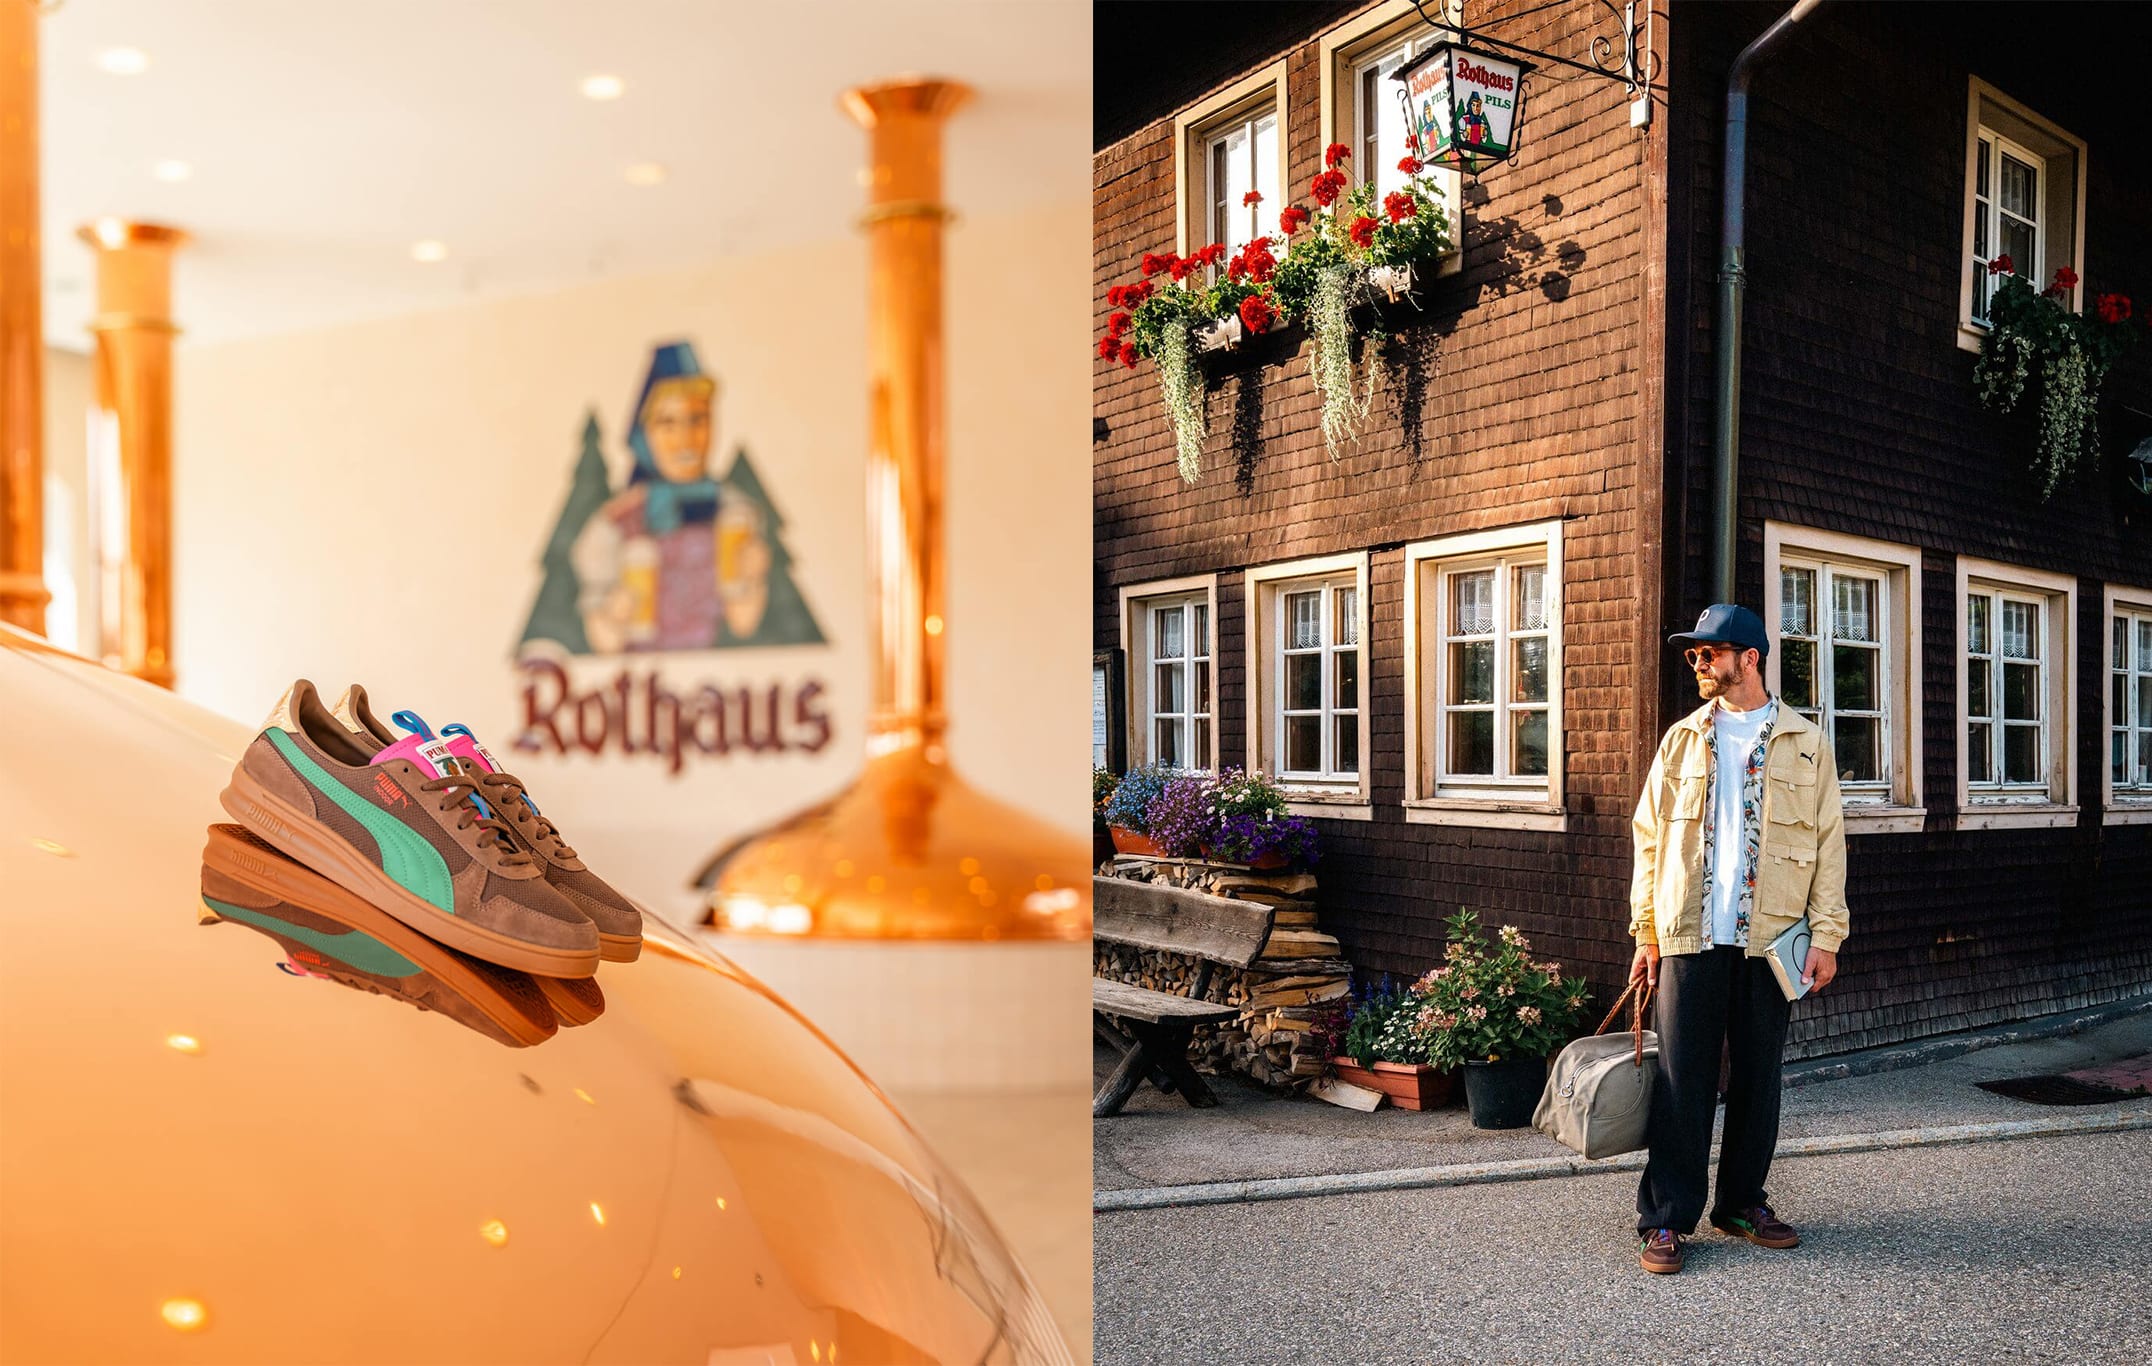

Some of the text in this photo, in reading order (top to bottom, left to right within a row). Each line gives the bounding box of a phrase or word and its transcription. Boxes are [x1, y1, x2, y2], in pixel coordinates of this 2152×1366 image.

[1411, 66, 1446, 97] Rothaus
[1456, 57, 1514, 92] Rothaus
[1431, 88, 1449, 105] PILS
[1484, 94, 1512, 110] PILS
[511, 658, 833, 775] Rothaus
[374, 771, 403, 801] PUMA
[248, 802, 282, 834] PUMA
